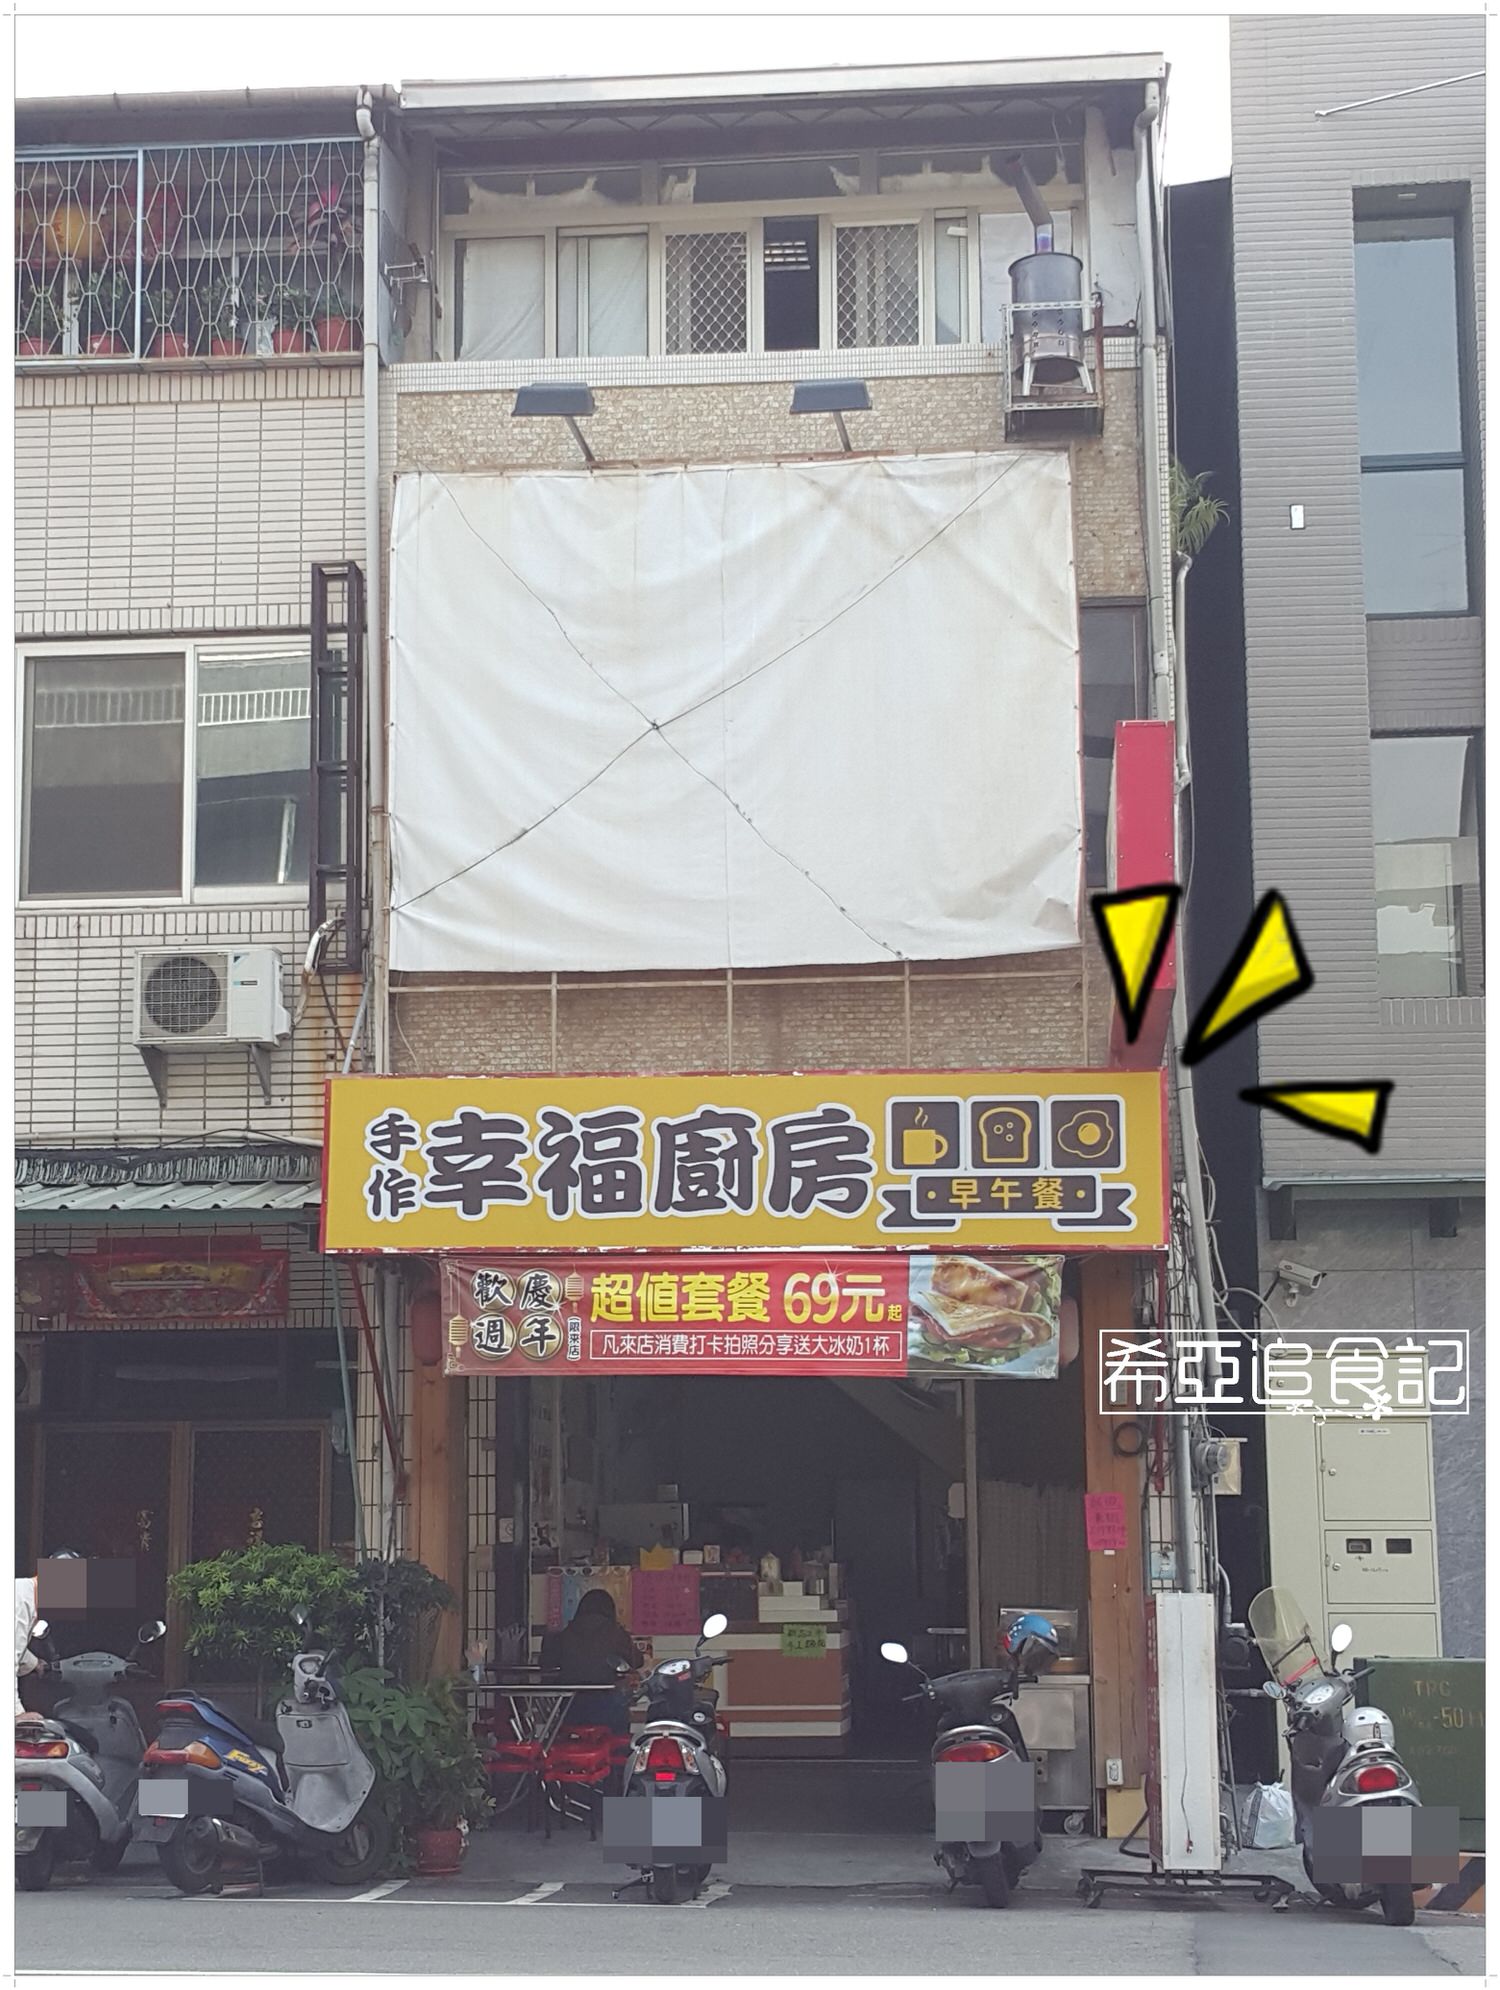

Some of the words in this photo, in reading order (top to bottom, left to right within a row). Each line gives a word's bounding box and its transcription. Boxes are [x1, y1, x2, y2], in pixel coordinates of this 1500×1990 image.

[371, 1112, 418, 1217] 手作
[423, 1108, 874, 1216] 幸福廚房
[949, 1177, 1064, 1210] 早午餐
[590, 1271, 771, 1323] 超值套餐
[601, 1334, 890, 1357] 凡來店消費打卡拍照分享送大冰奶1杯
